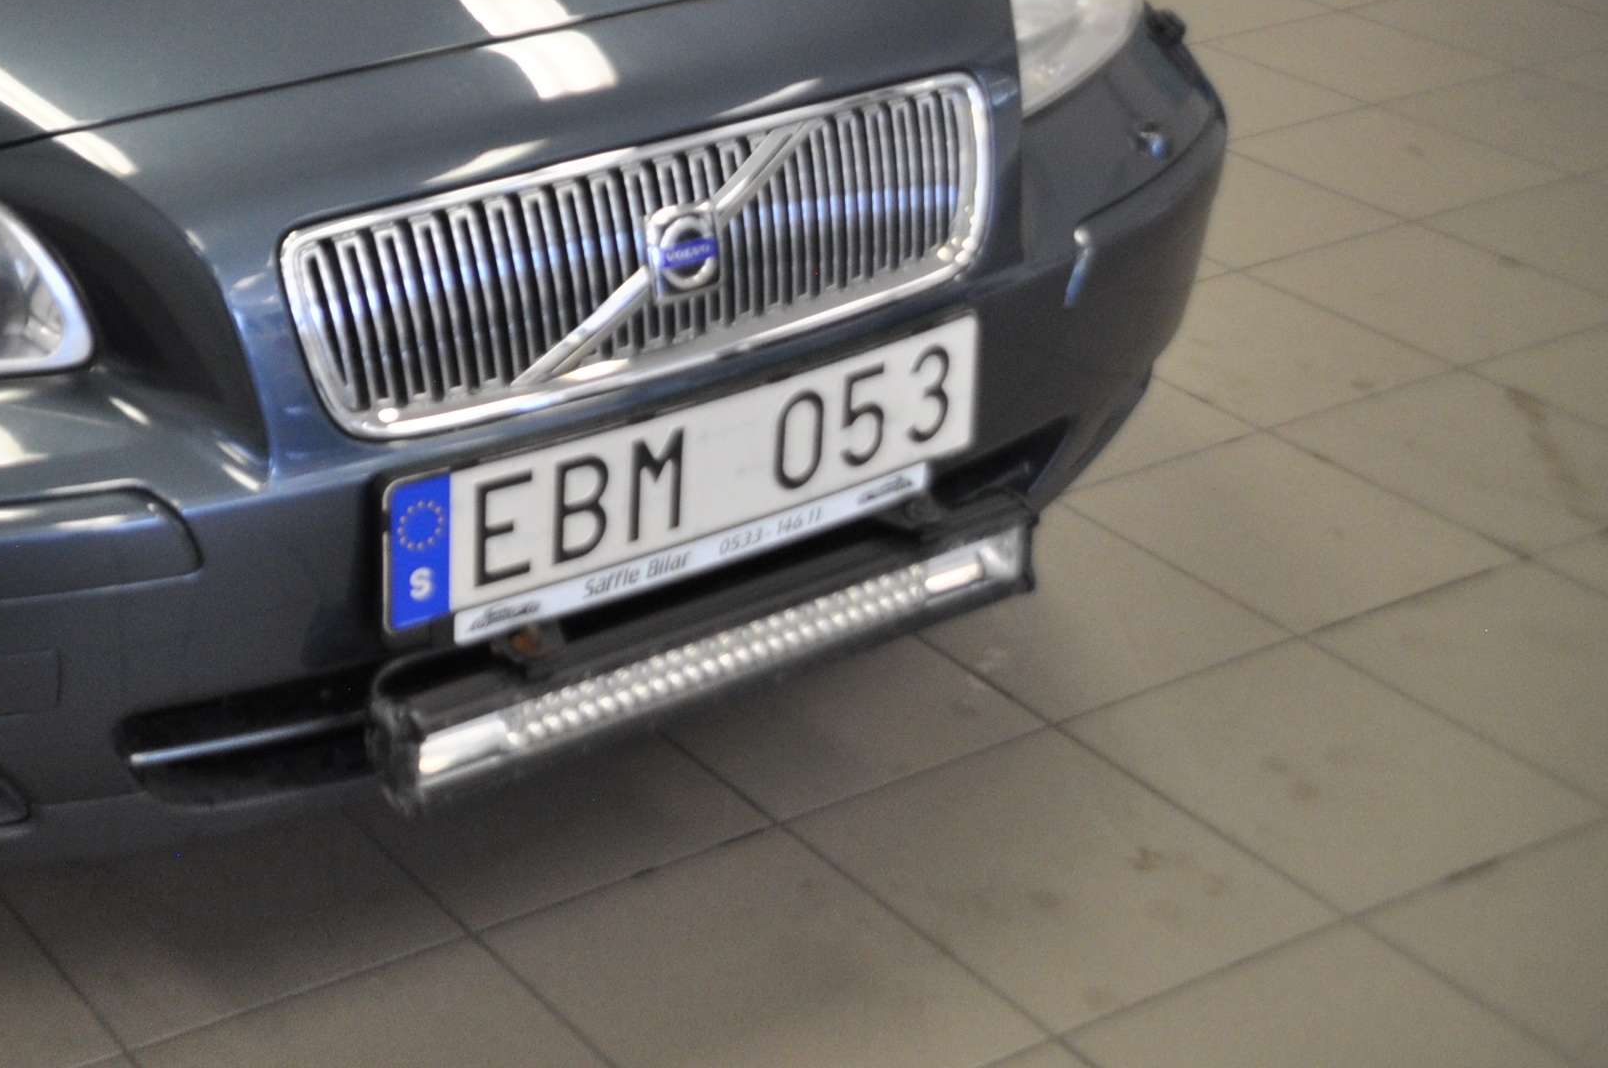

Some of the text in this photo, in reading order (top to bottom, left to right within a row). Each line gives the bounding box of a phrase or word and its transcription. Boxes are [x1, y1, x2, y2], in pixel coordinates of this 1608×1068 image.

[474, 344, 951, 587] EBM 053
[646, 549, 692, 578] Bilar
[409, 566, 434, 601] S
